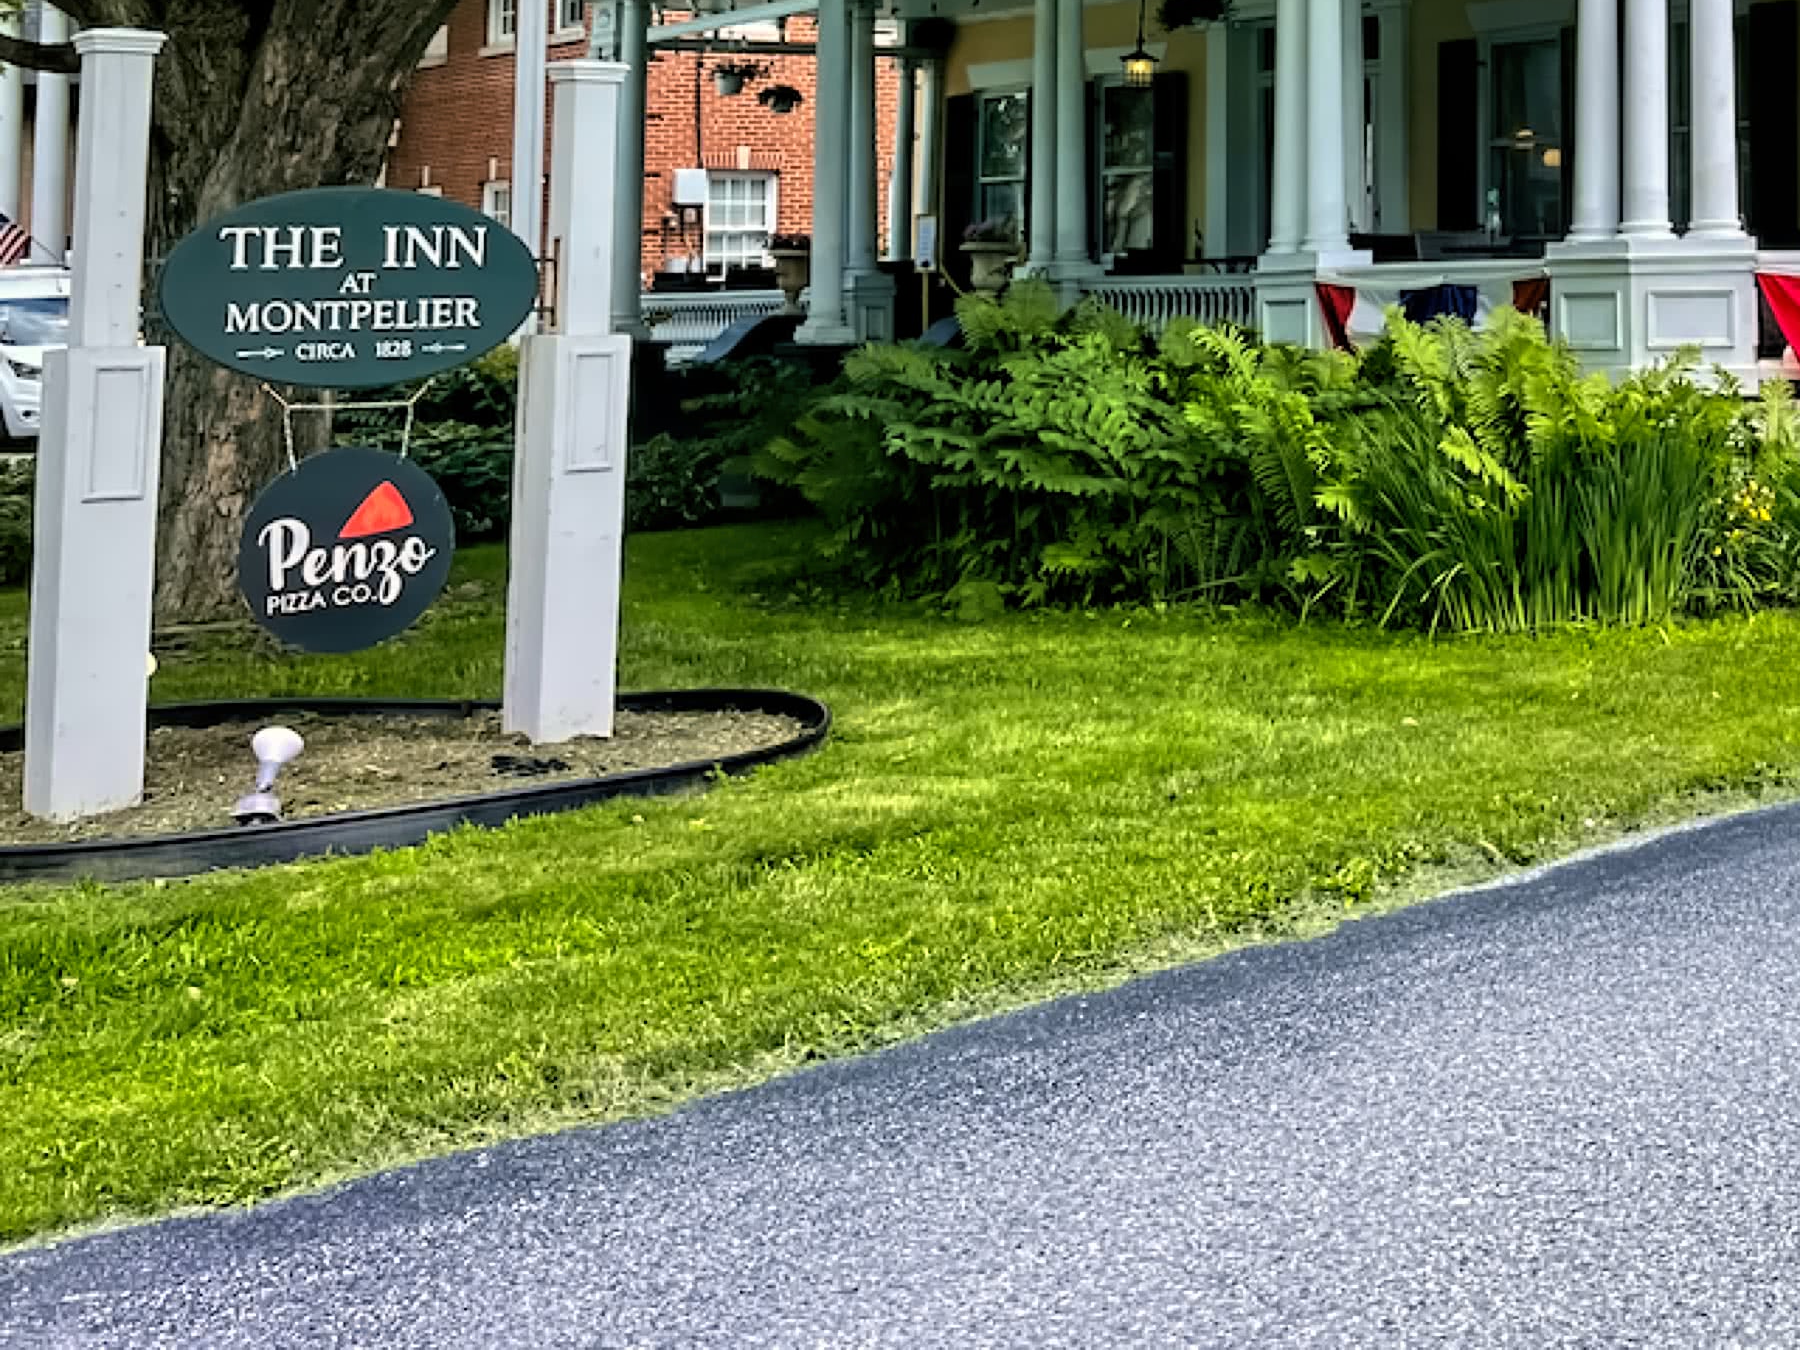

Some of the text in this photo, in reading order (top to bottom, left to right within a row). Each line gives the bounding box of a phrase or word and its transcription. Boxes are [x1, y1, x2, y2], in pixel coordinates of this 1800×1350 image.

[219, 225, 487, 269] THE INN
[339, 272, 377, 293] AT
[224, 297, 481, 333] MONTPELIER
[295, 340, 413, 360] CIRCA 1828
[258, 516, 438, 605] Penzo
[266, 585, 379, 616] PIZZA CO.
